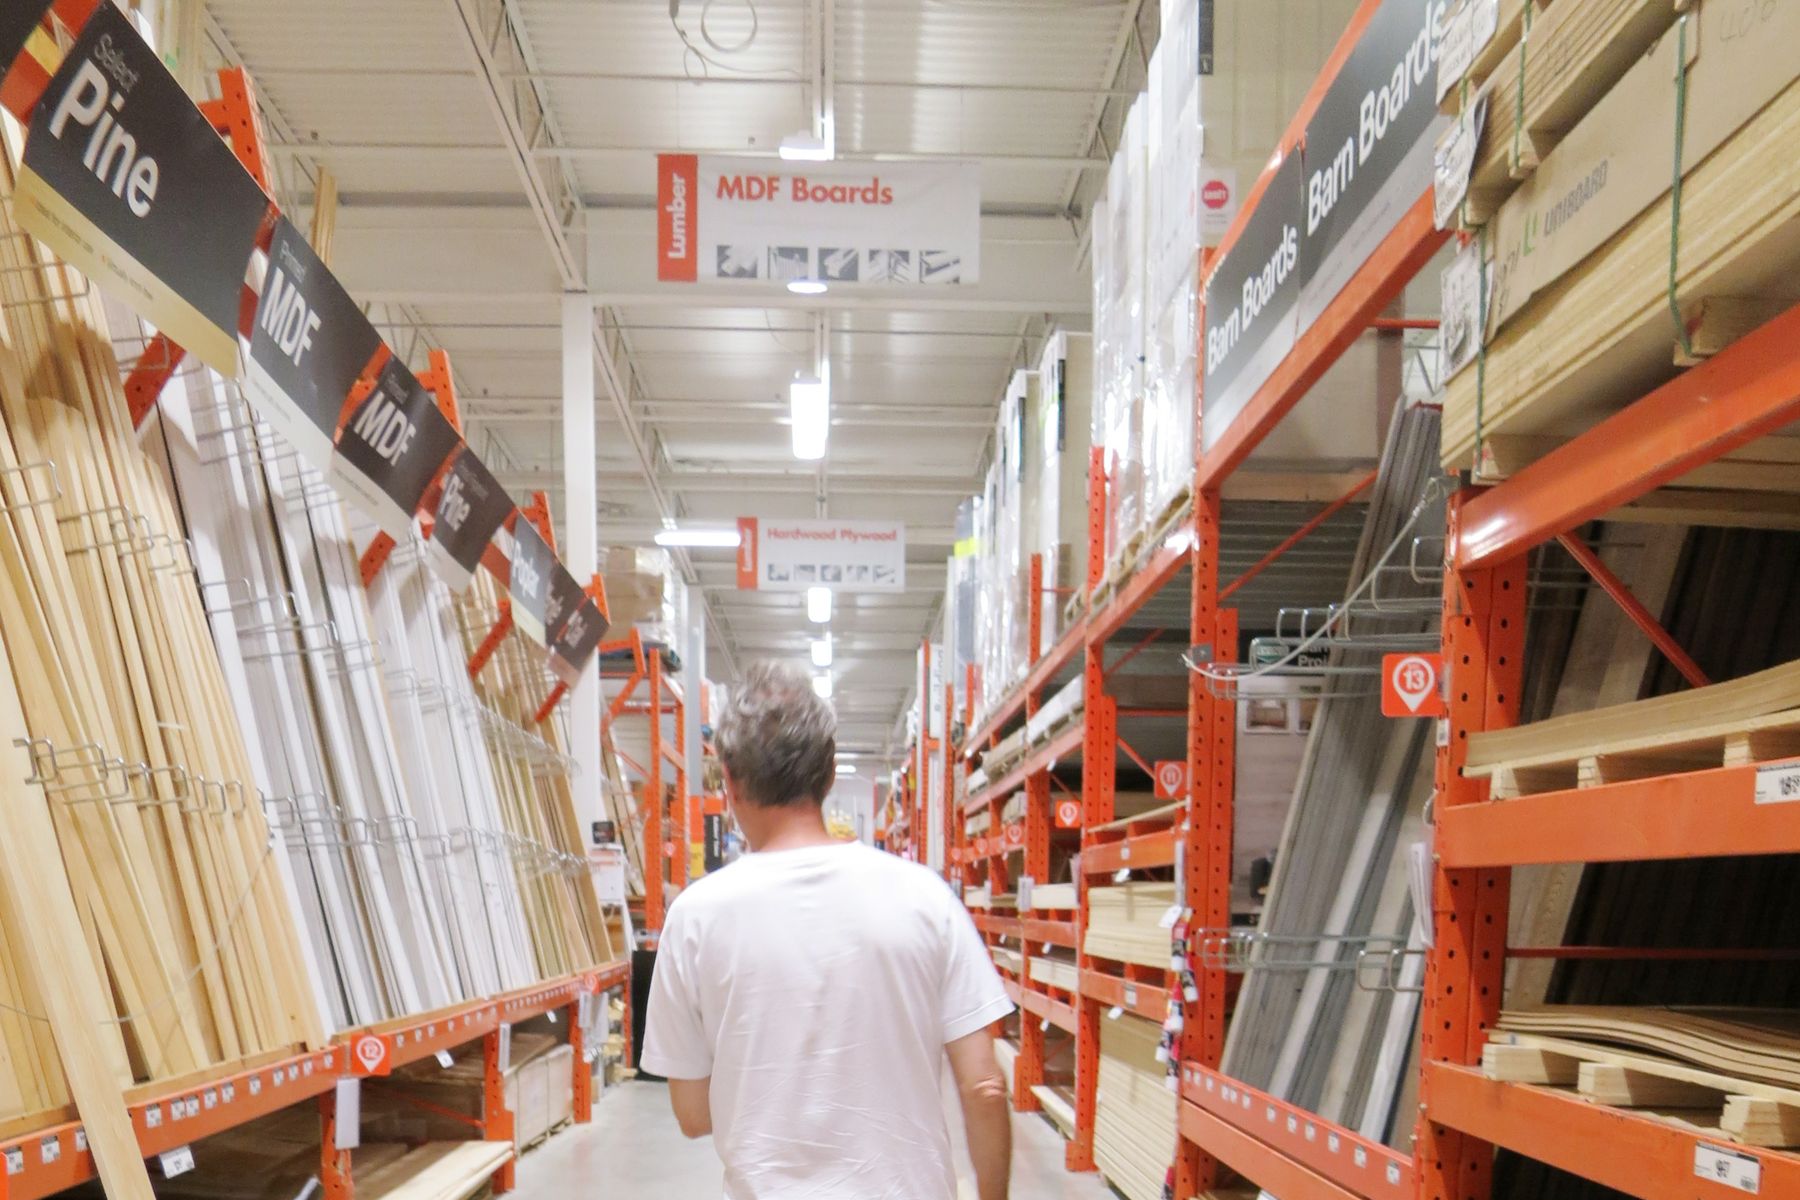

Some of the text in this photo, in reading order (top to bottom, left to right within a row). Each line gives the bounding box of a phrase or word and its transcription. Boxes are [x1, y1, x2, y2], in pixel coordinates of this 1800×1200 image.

[48, 57, 159, 219] Pine
[1307, 136, 1354, 237] Barn
[1358, 0, 1447, 167] Boards
[666, 172, 686, 259] Lumber
[716, 175, 894, 205] MDF Boards
[1543, 159, 1608, 237] UNIBOARD
[261, 266, 322, 367] MDF
[1206, 223, 1298, 376] Barn Boards
[353, 390, 417, 467] MDF
[767, 528, 897, 543] Hardwood Plywood
[1402, 670, 1425, 691] 13
